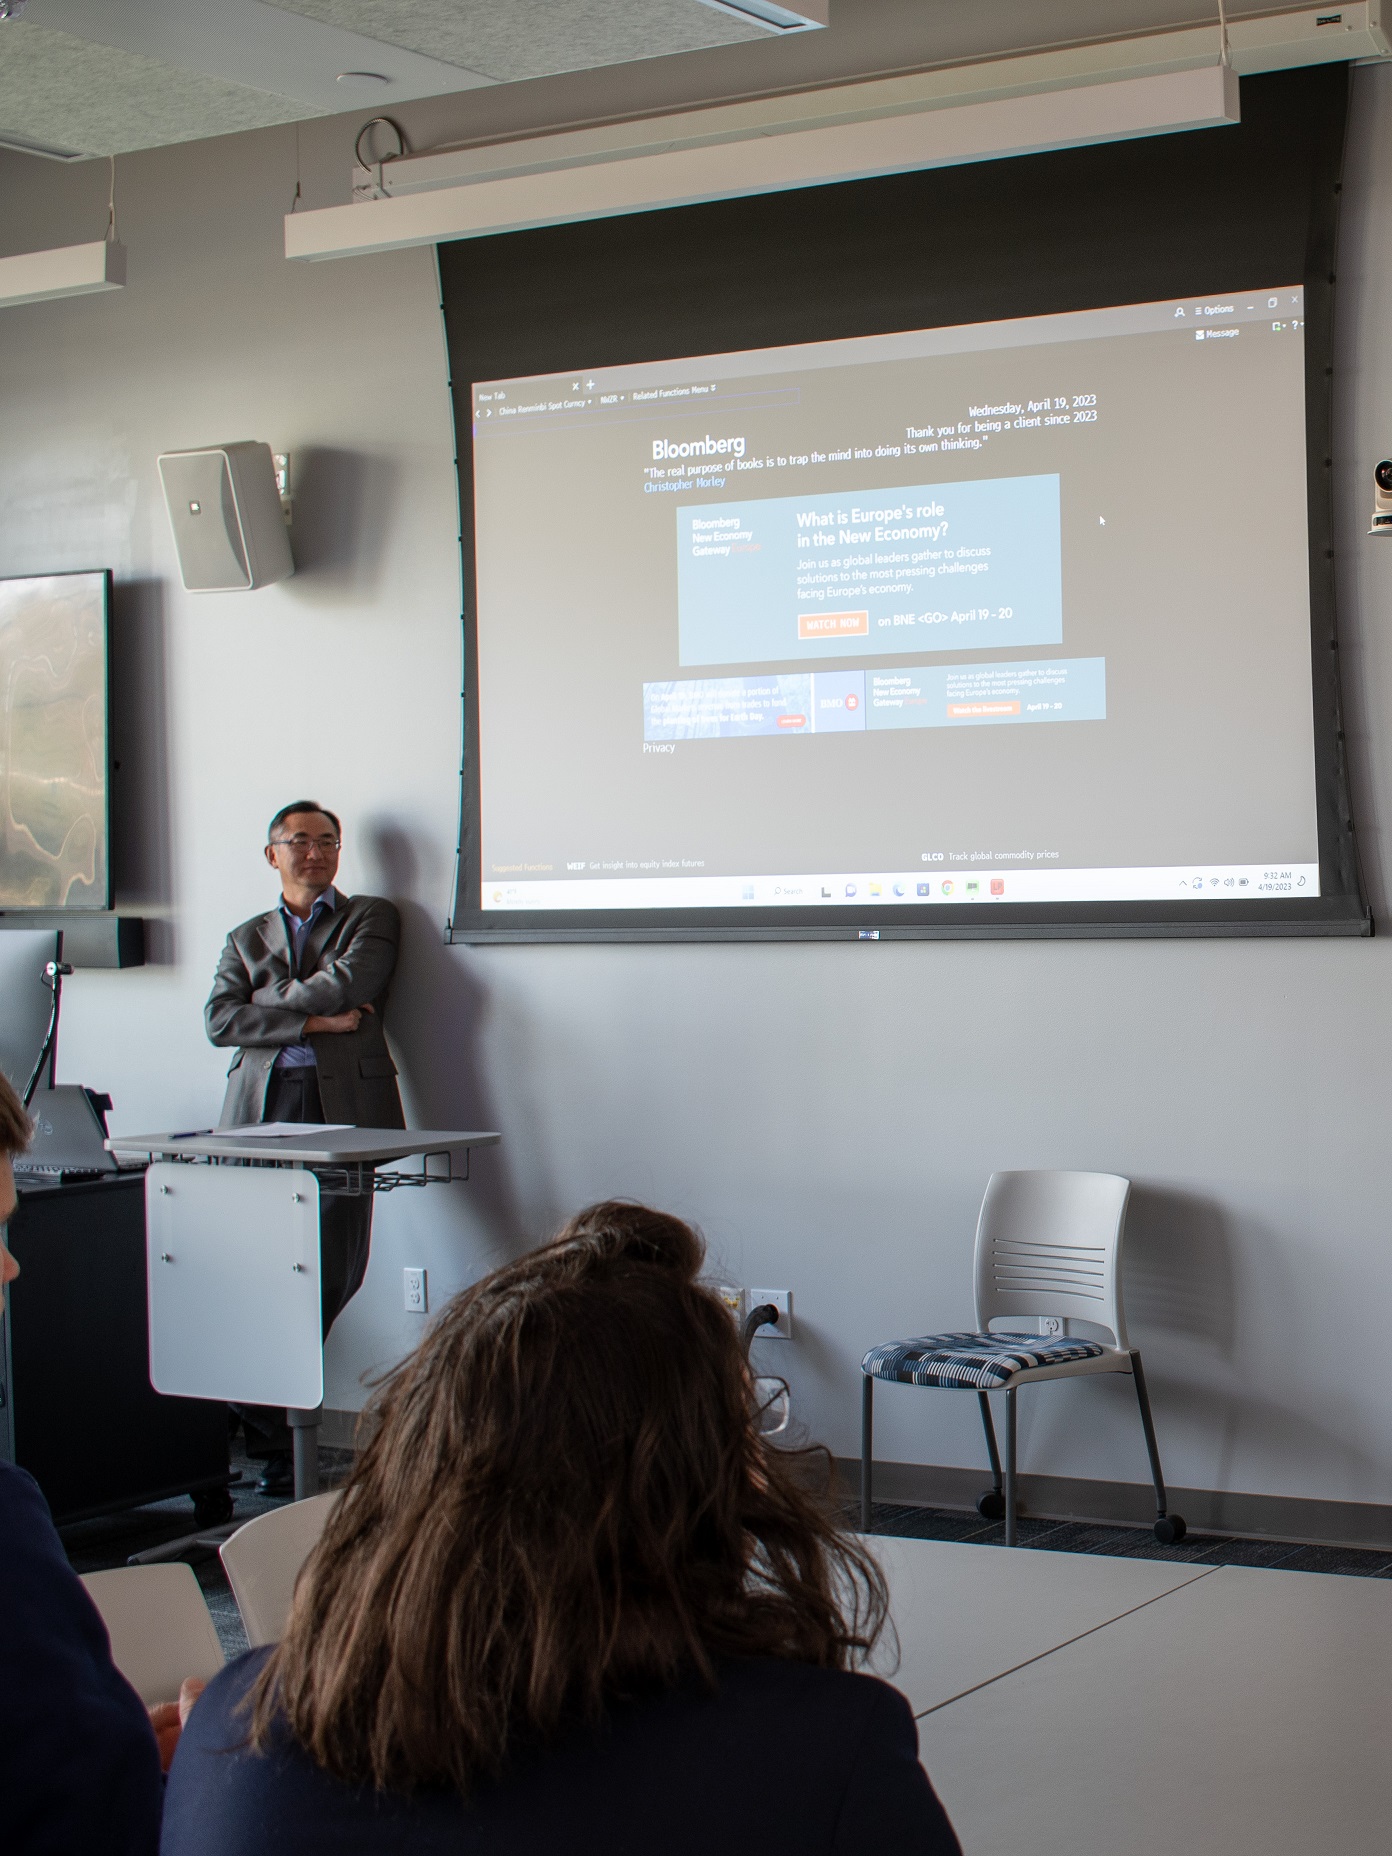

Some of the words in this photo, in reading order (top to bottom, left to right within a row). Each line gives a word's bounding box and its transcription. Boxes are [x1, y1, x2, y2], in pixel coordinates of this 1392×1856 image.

[1206, 329, 1239, 338] Message
[968, 402, 1024, 417] Wednesday,
[1027, 399, 1050, 415] April
[1054, 397, 1069, 411] 19,
[1072, 395, 1096, 408] 2023
[906, 425, 934, 439] Thank
[937, 426, 954, 439] you
[957, 423, 971, 435] for
[974, 420, 1001, 434] being
[1004, 421, 1010, 431] a
[1013, 416, 1041, 430] client
[1044, 415, 1070, 427] since
[1073, 411, 1097, 425] 2023
[652, 436, 744, 460] Bloomberg
[644, 466, 665, 478] "The
[667, 464, 684, 477] real
[687, 463, 722, 478] purpose
[724, 459, 734, 472] of
[736, 457, 763, 470] books
[766, 456, 774, 468] is
[776, 455, 786, 467] to
[789, 454, 808, 468] trap
[810, 452, 826, 464] the
[828, 449, 851, 462] mind
[854, 447, 872, 460] into
[874, 445, 900, 459] doing
[903, 444, 916, 456] its
[918, 444, 938, 454] own
[940, 437, 988, 453] thinking."
[644, 478, 692, 493] Christopher
[696, 476, 725, 490] Morley
[796, 511, 834, 529] What
[837, 510, 848, 526] is
[851, 505, 913, 527] Europe's
[916, 502, 944, 519] role
[797, 532, 809, 548] in
[813, 530, 835, 547] the
[839, 529, 871, 545] New
[874, 522, 948, 543] Economy?
[642, 742, 675, 755] Privacy
[921, 852, 944, 861] GLCO
[949, 851, 968, 861] Track
[970, 851, 992, 863] global
[994, 850, 1034, 862] commodity
[1036, 850, 1059, 862] prices
[1263, 871, 1278, 879] 9:32
[1258, 882, 1291, 891] 4/19/2023
